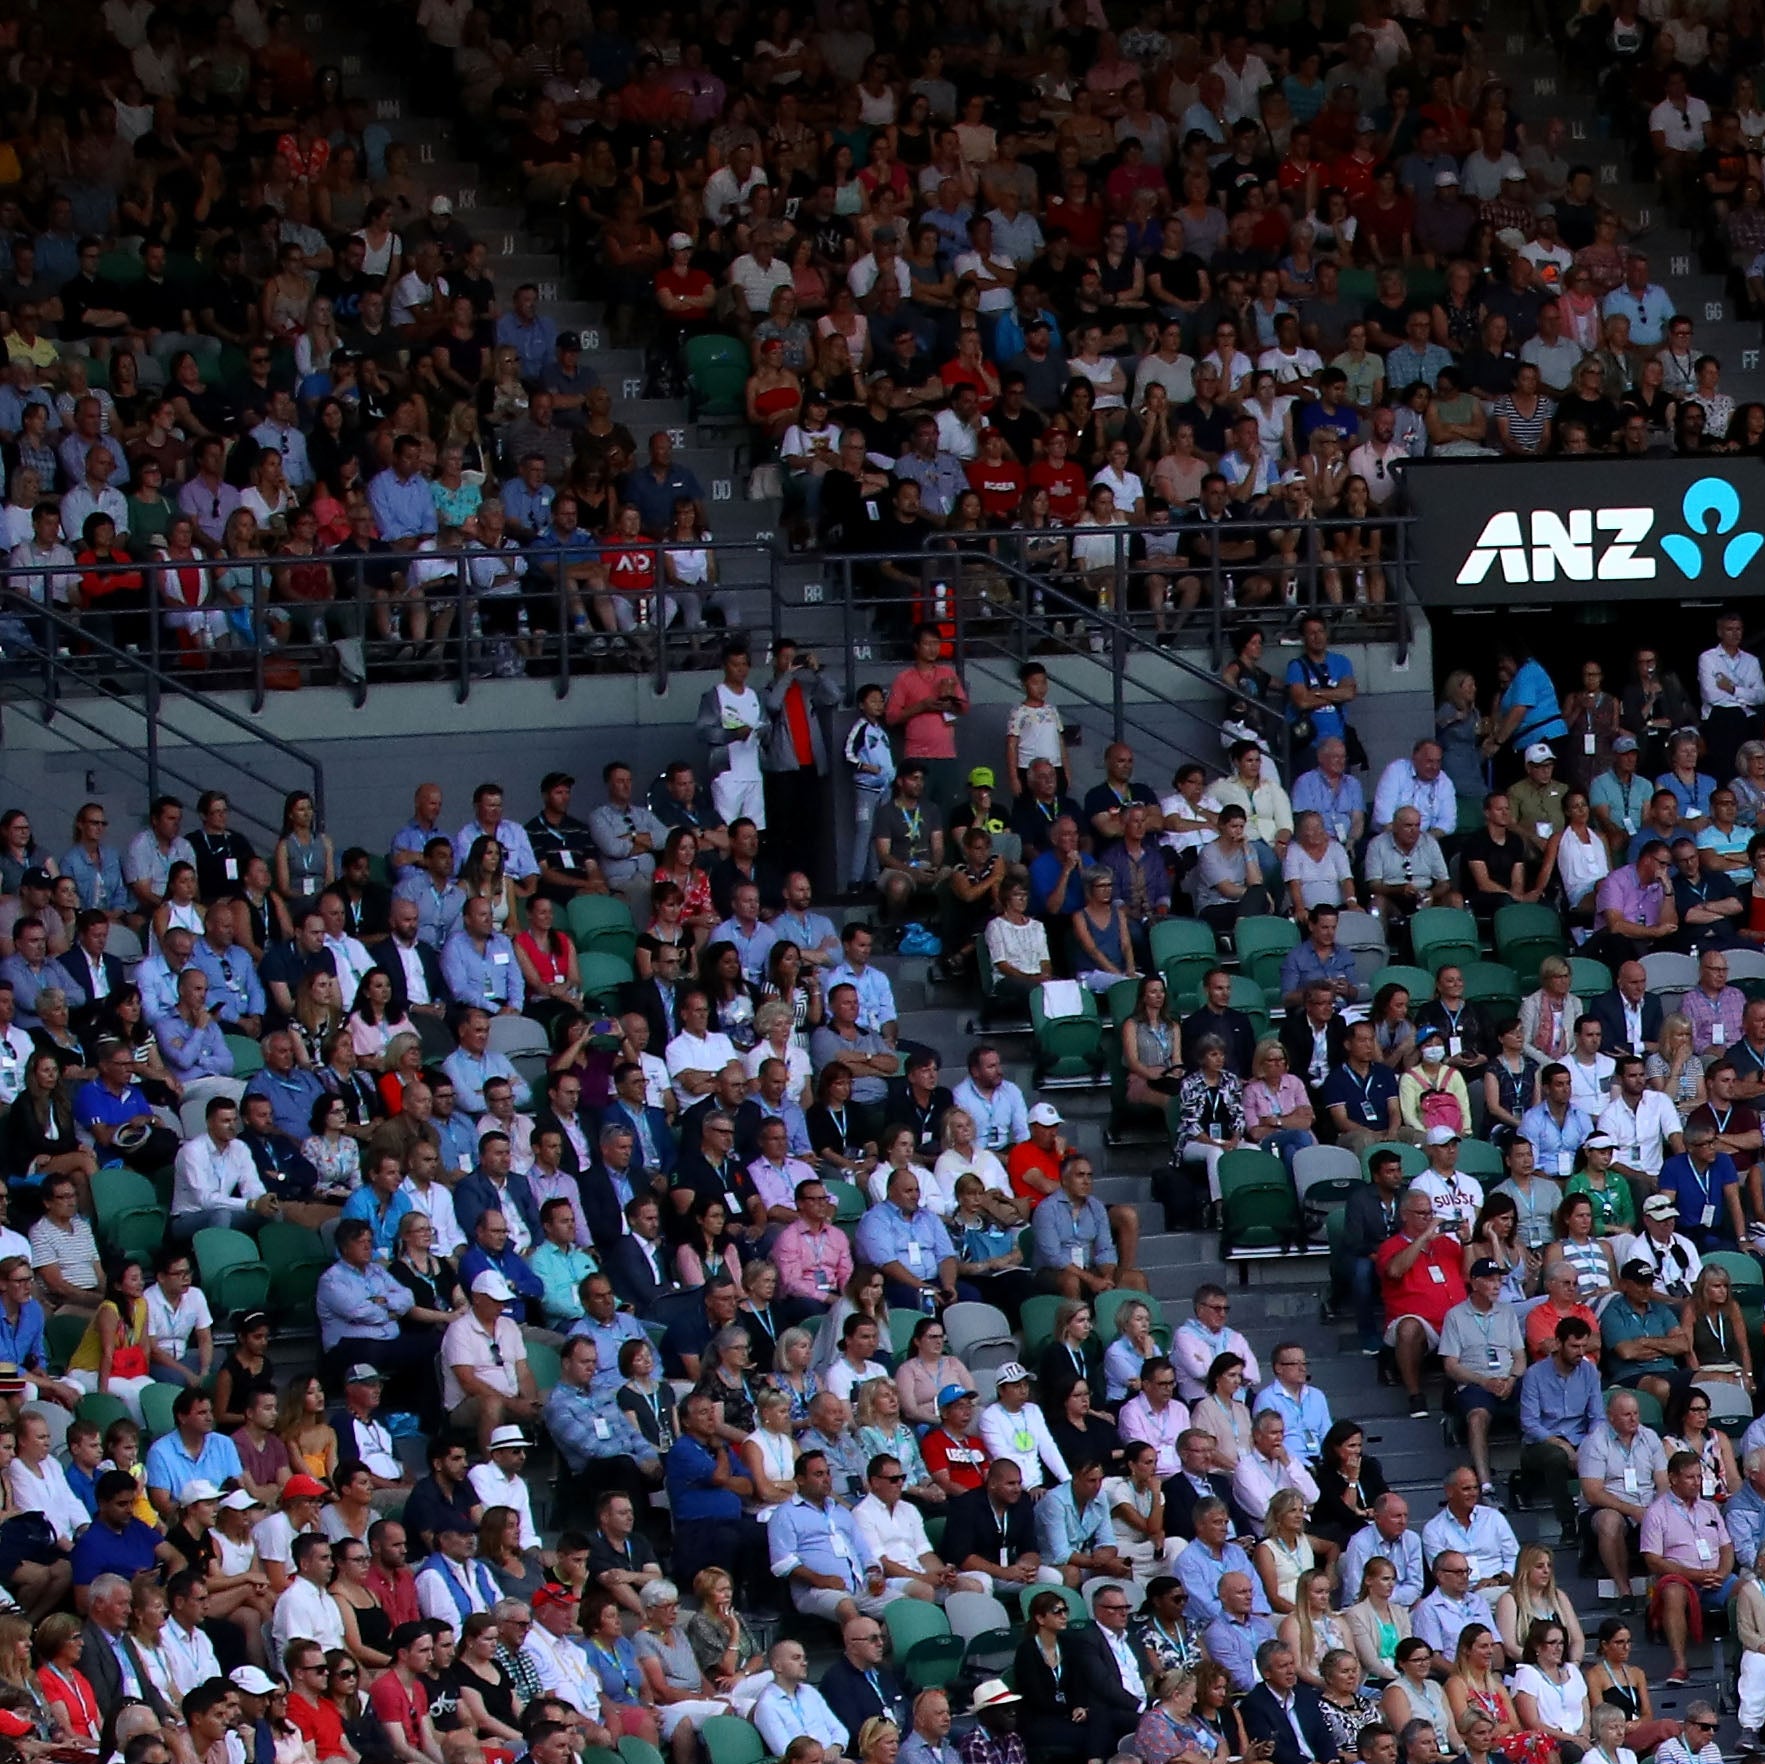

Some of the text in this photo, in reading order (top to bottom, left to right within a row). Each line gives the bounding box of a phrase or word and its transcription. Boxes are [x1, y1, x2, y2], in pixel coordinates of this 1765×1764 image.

[1572, 120, 1588, 139] LL
[421, 144, 435, 163] LL
[502, 235, 514, 256] JJ
[1670, 255, 1689, 275] HH
[538, 282, 557, 301] HH
[1705, 302, 1723, 320] GG
[580, 330, 599, 349] GG
[1742, 350, 1760, 369] FF
[623, 379, 641, 399] FF
[712, 480, 731, 500] DD
[1456, 507, 1656, 584] ANZ
[1433, 1189, 1474, 1208] SUISSE
